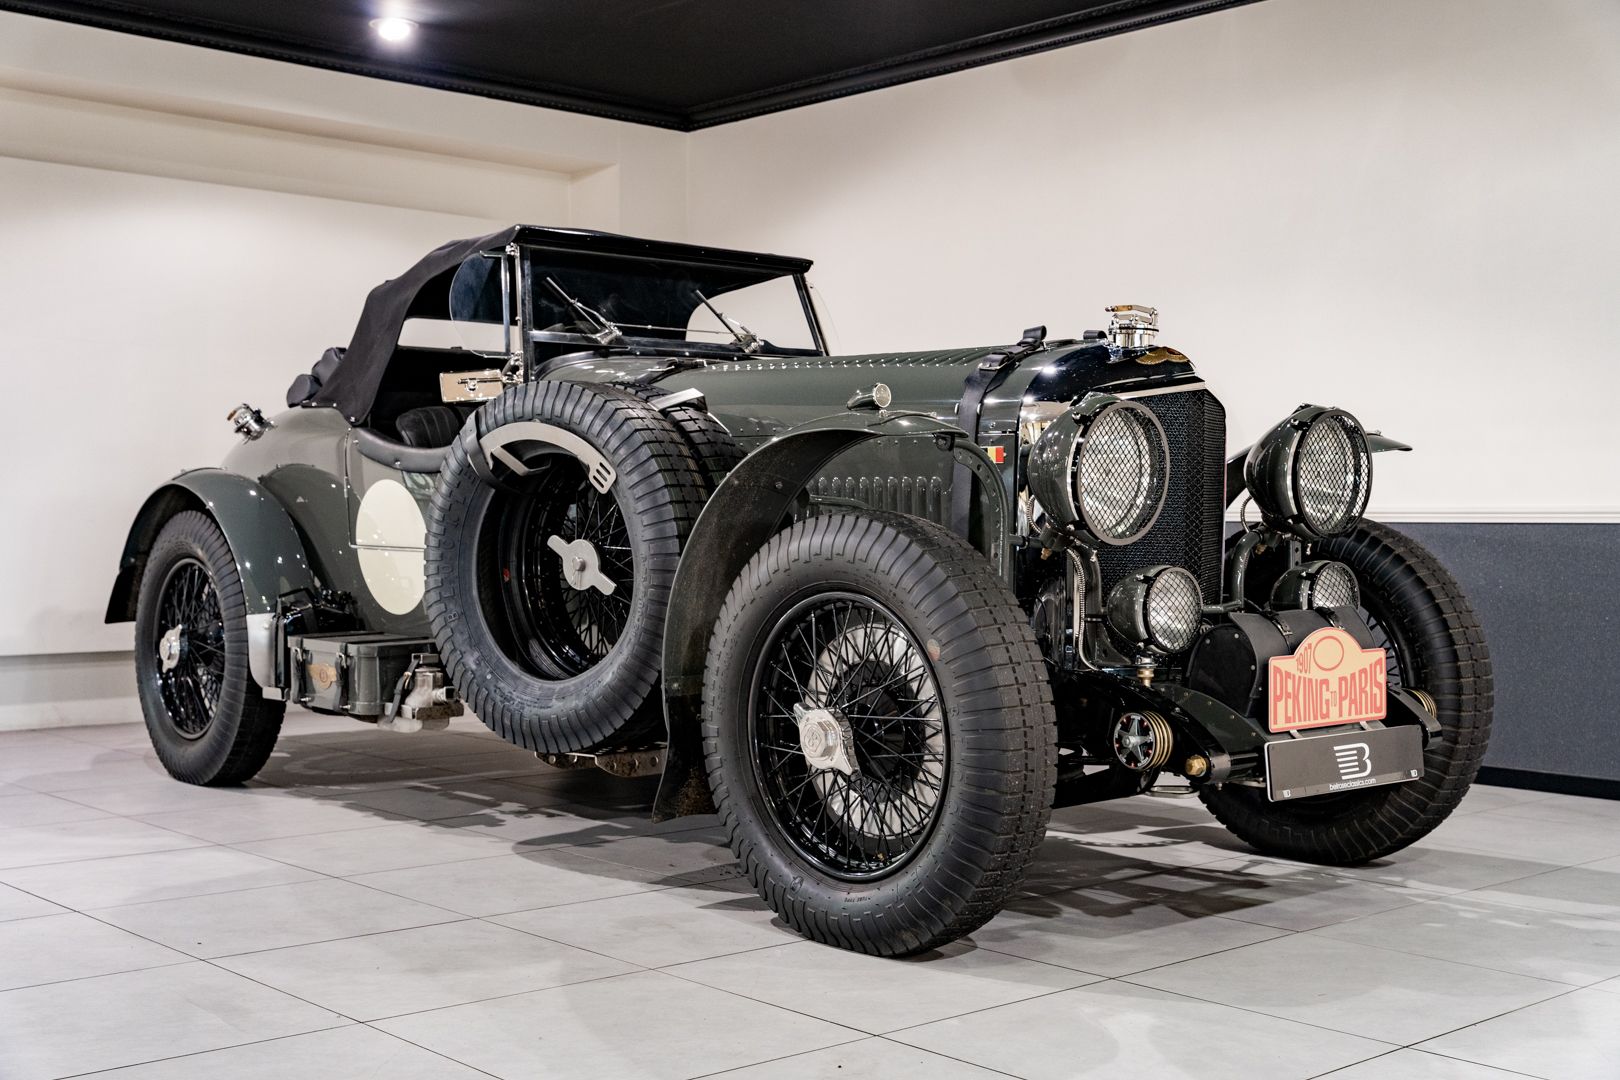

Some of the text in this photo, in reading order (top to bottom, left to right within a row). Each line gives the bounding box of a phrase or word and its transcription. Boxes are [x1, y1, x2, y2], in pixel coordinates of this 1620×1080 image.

[1295, 643, 1312, 675] 1907
[1273, 657, 1383, 725] PEKING TO PARIS
